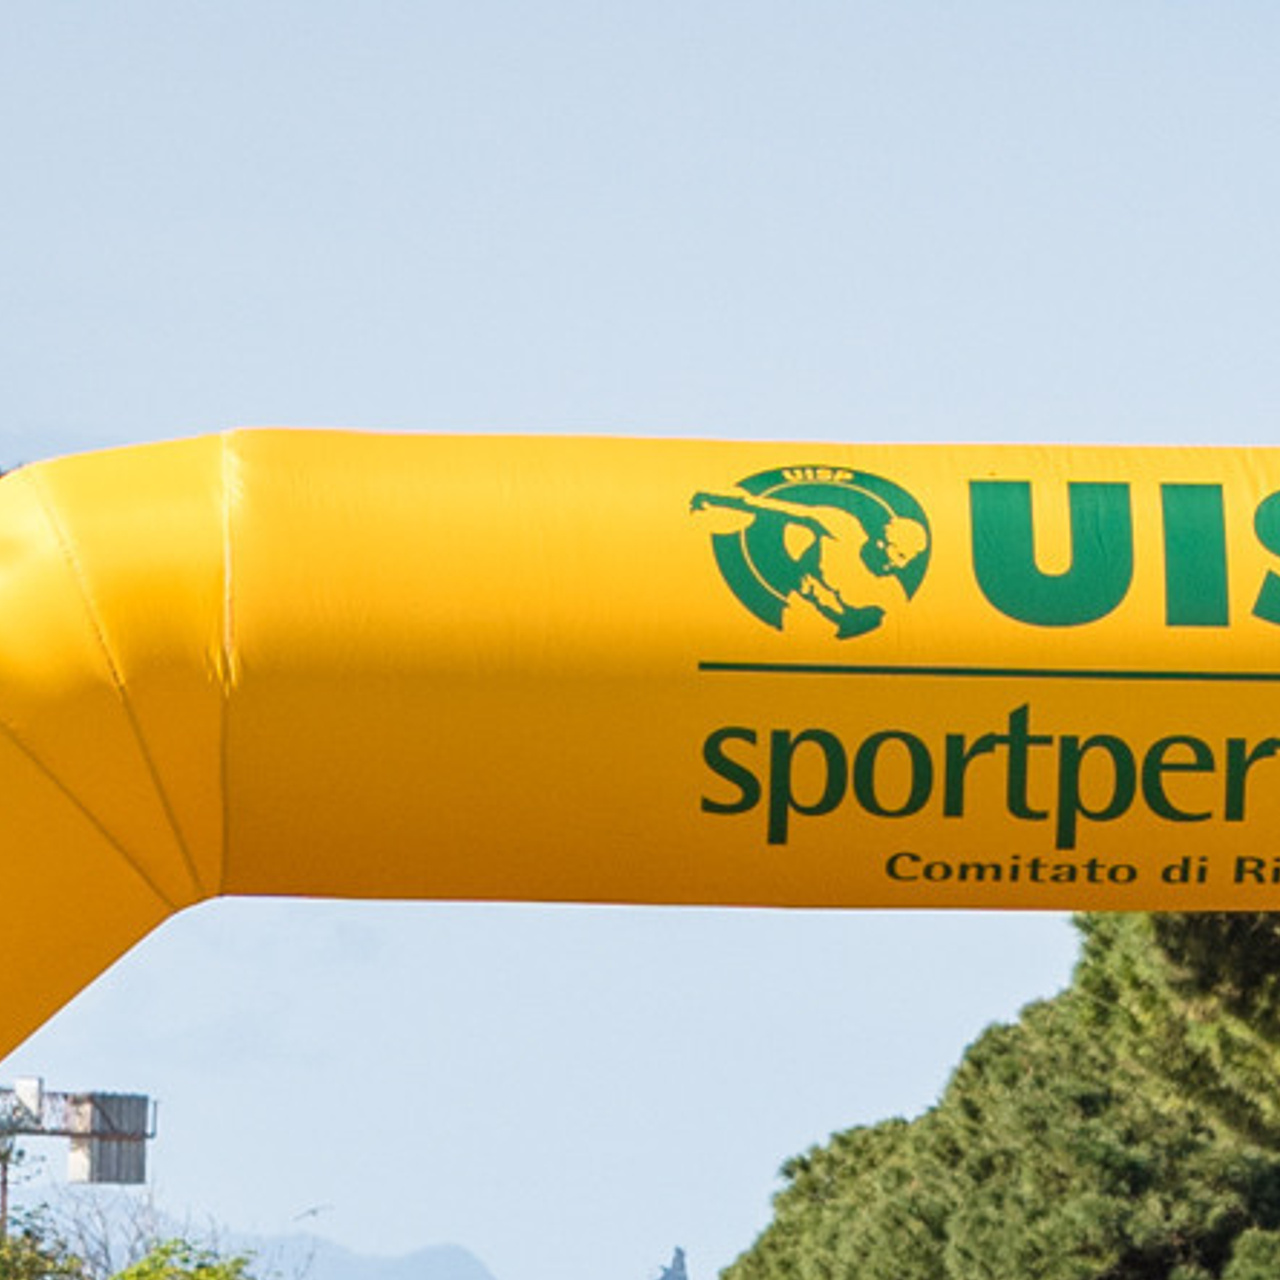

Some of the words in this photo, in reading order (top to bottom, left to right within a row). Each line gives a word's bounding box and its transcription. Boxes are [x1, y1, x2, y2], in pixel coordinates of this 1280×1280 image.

[782, 468, 854, 481] UISP
[885, 851, 1138, 884] Comitato
[1161, 855, 1207, 884] di
